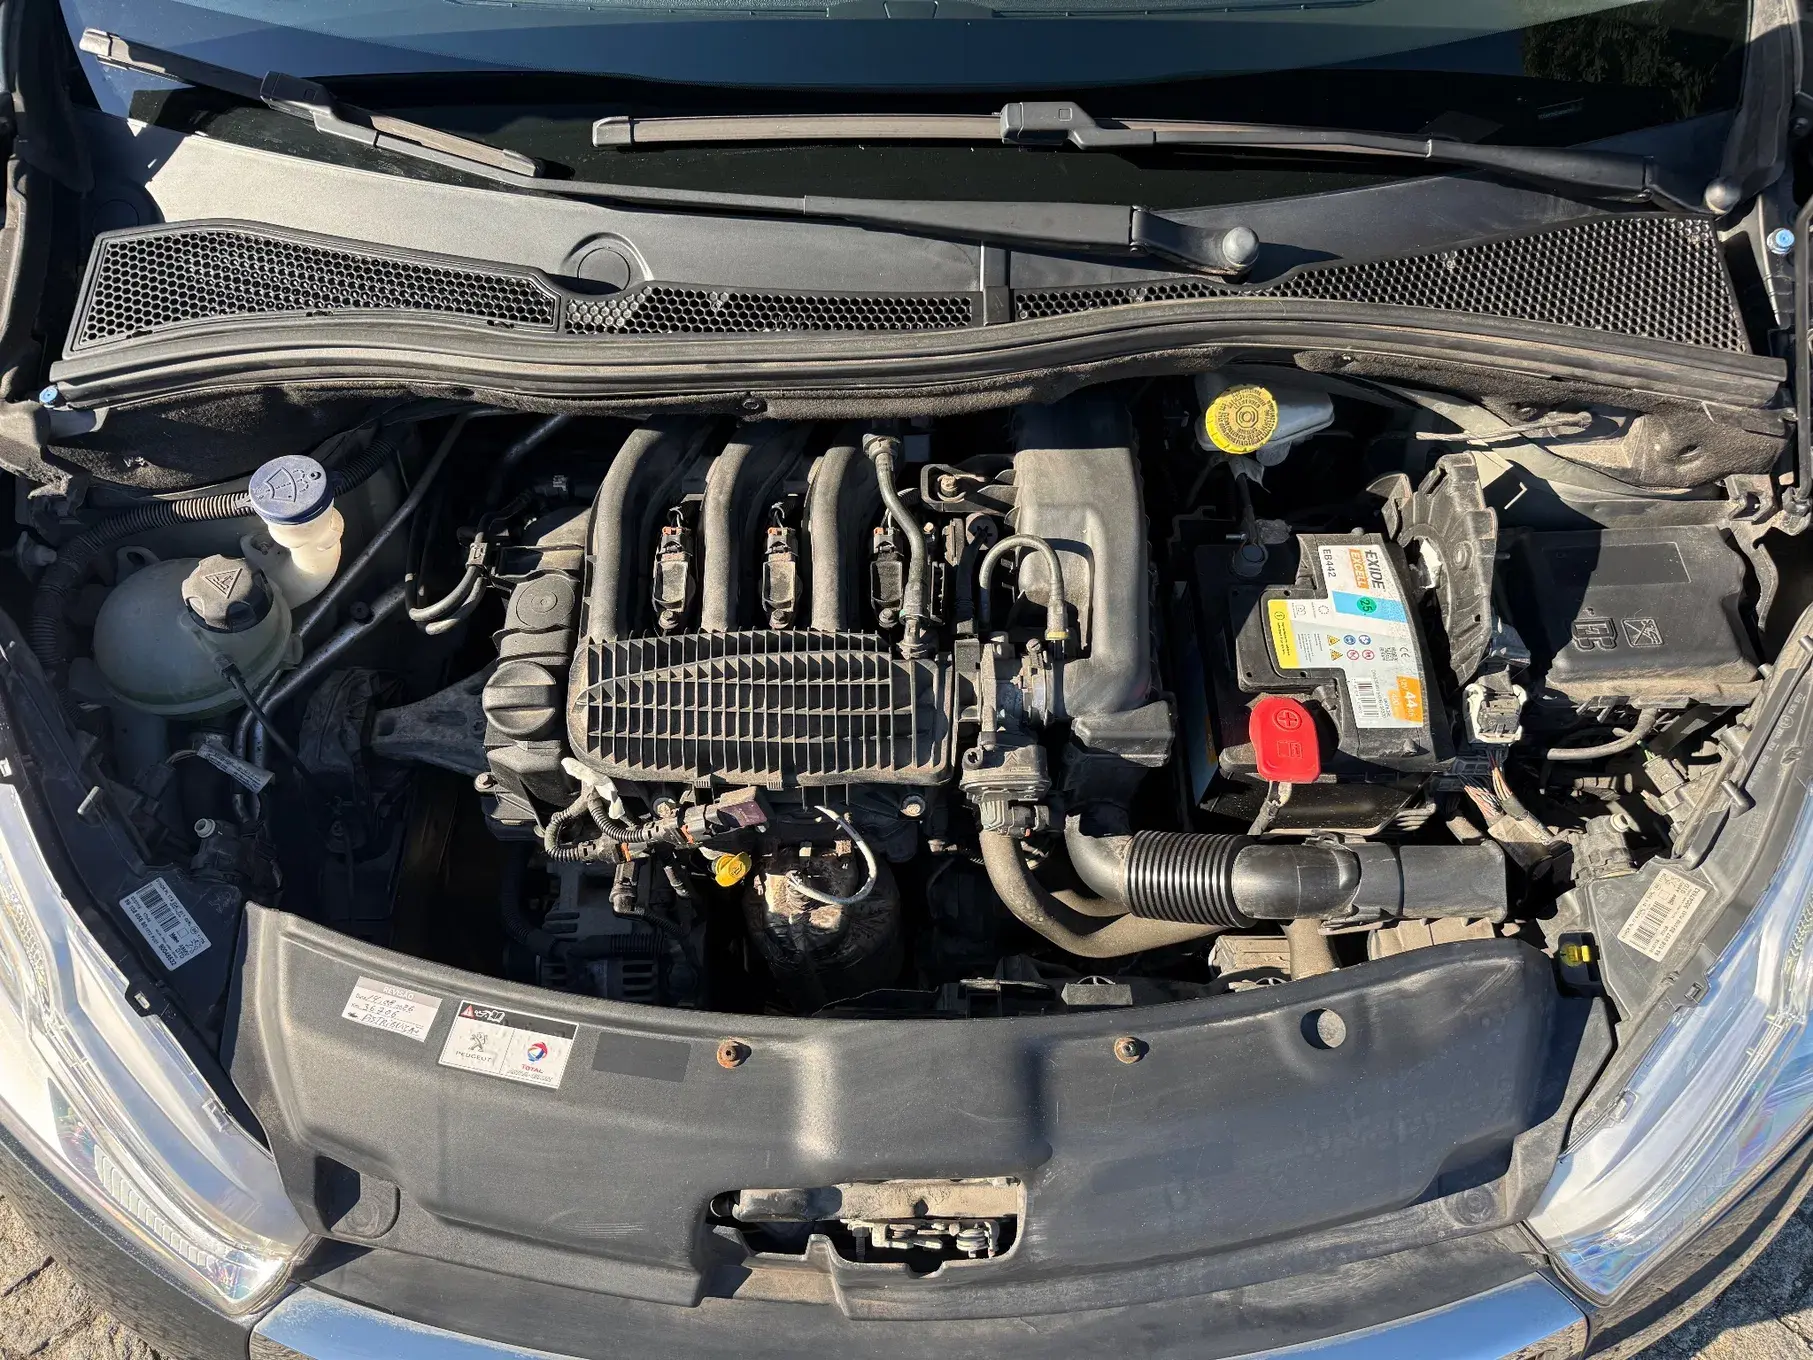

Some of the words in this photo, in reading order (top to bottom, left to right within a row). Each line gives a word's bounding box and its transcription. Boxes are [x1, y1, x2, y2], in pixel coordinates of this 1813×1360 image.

[1323, 549, 1336, 578] EB442
[1350, 552, 1367, 588] EXCELL
[1365, 550, 1385, 590] EXIDE
[1360, 599, 1373, 612] 25
[1404, 691, 1418, 708] 44
[383, 985, 414, 1000] REVISÃO
[455, 1050, 492, 1062] PEUGEOT
[522, 1063, 544, 1074] TOTAL
